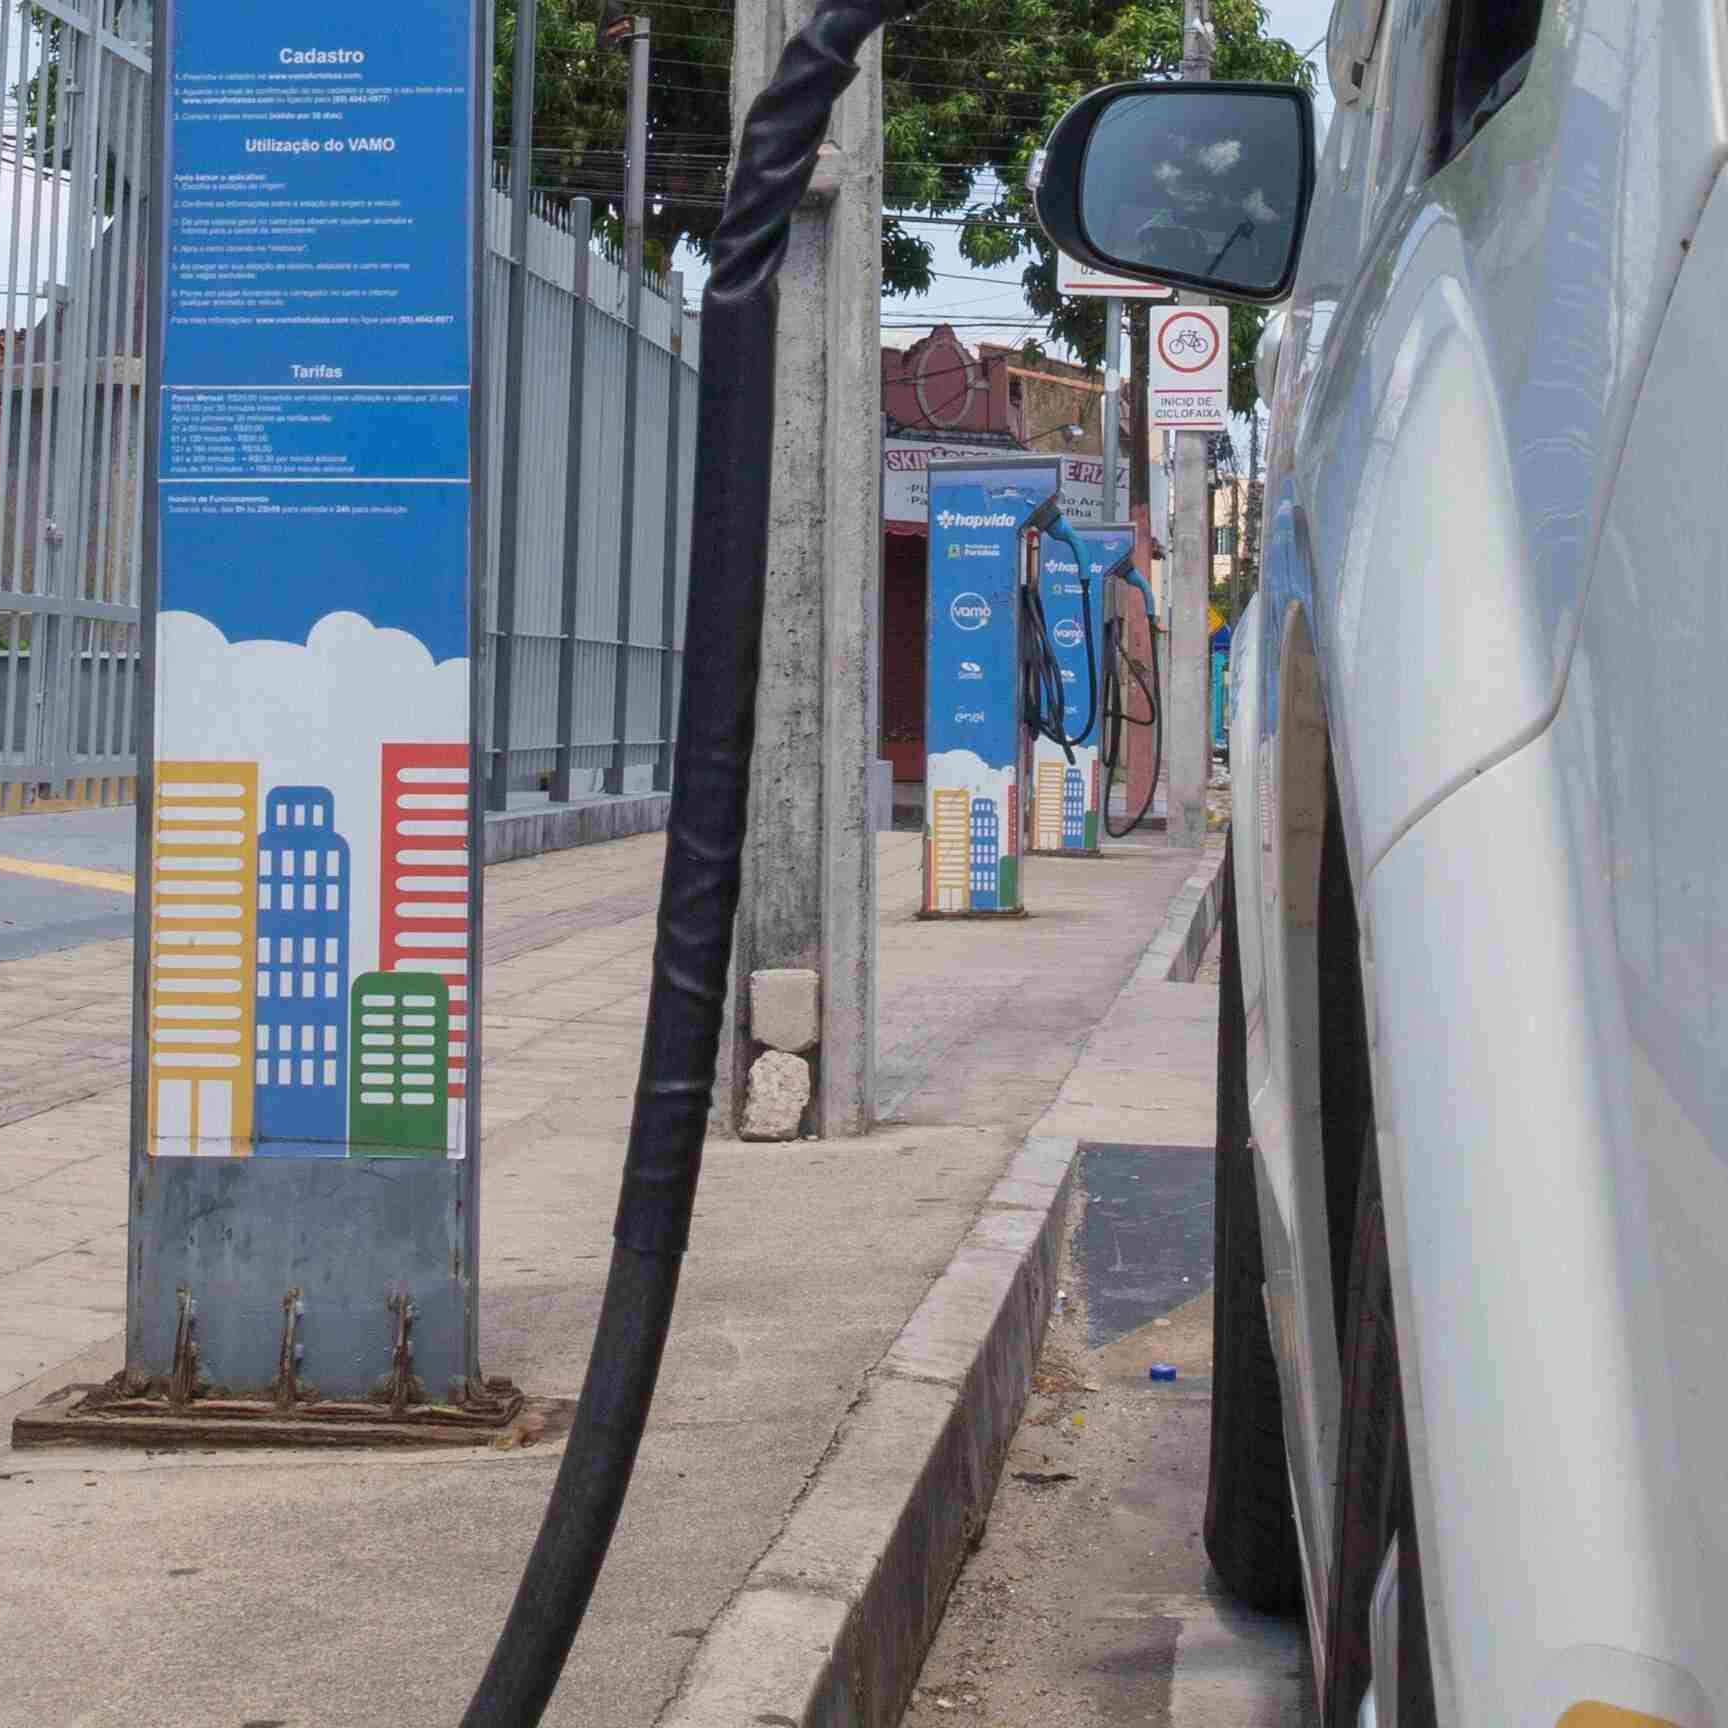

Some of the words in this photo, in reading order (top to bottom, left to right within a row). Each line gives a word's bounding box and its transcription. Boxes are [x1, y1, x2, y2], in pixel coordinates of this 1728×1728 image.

[279, 48, 365, 65] Cadastro
[245, 137, 320, 155] Utilização
[324, 137, 345, 152] do
[348, 137, 396, 152] VAMO
[291, 364, 344, 379] Tarifas
[1155, 408, 1221, 418] CICLOFAIXA
[954, 512, 1016, 529] hapvida
[954, 606, 992, 618] vamo
